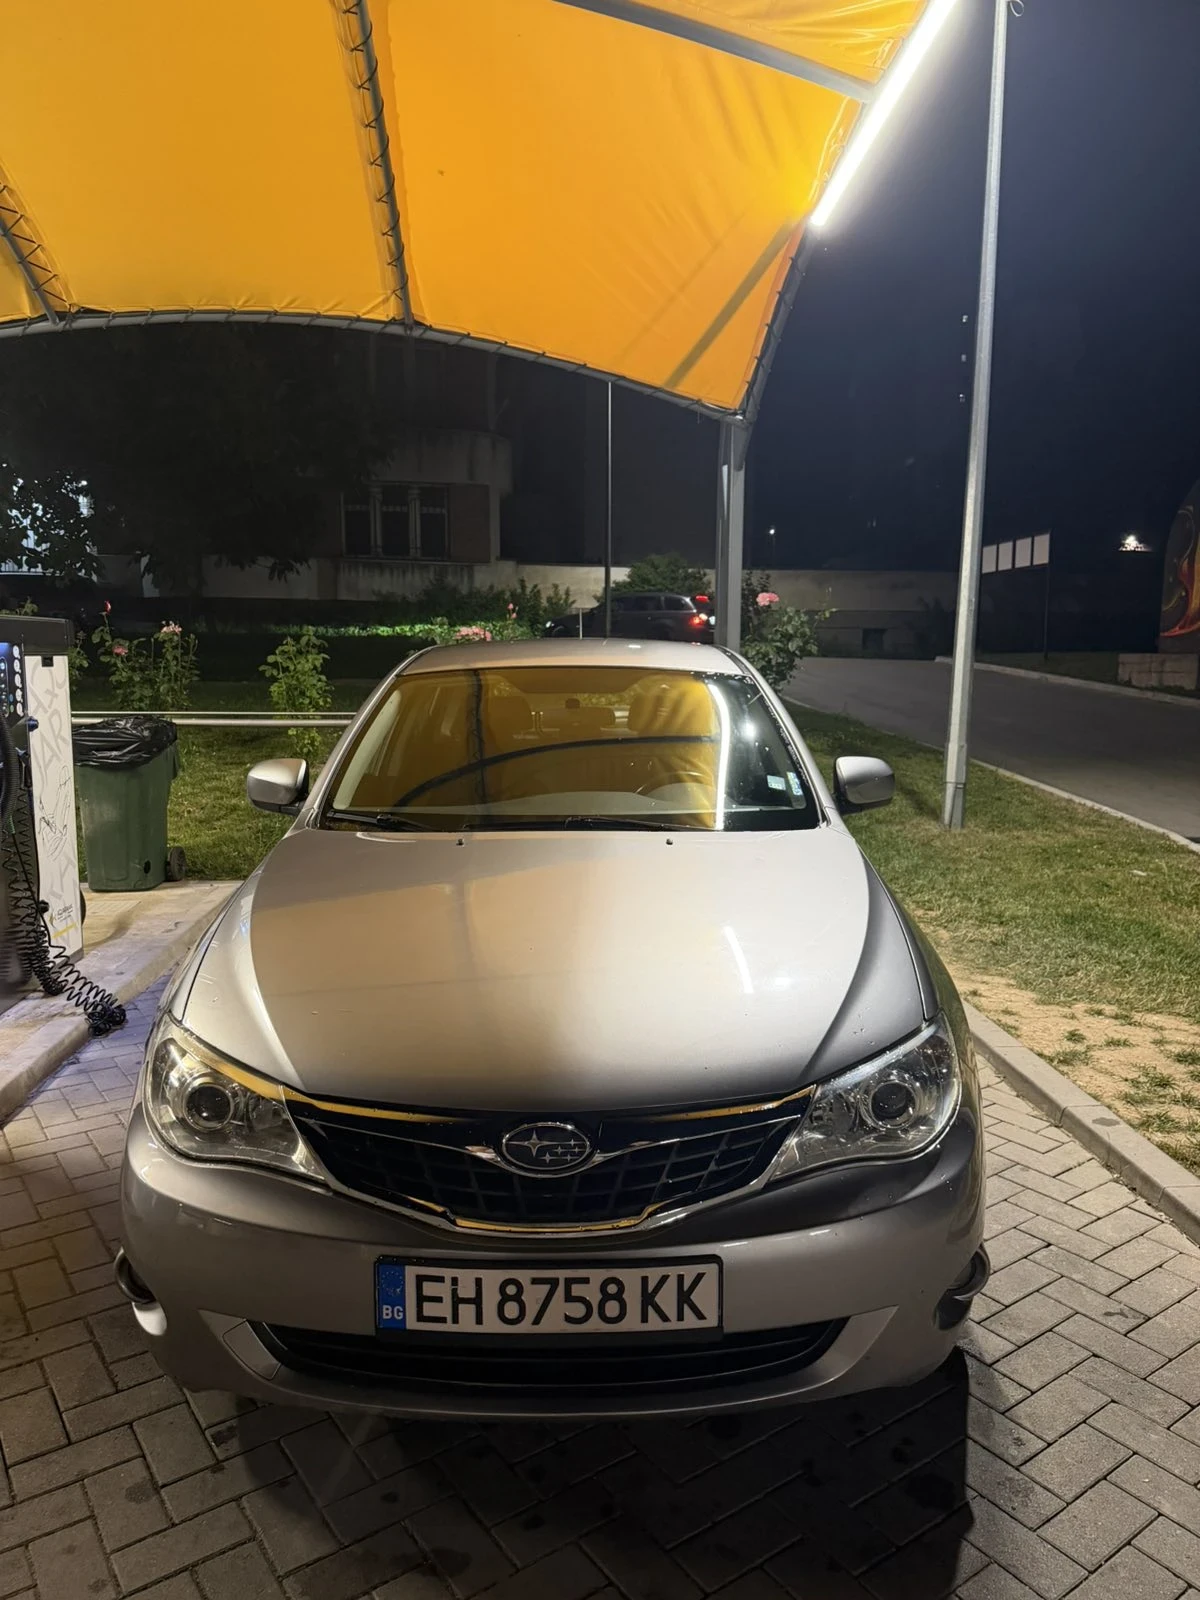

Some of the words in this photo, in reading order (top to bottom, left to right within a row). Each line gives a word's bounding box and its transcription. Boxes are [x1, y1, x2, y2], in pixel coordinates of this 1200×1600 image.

[382, 1305, 404, 1320] BG
[415, 1274, 484, 1326] EH
[497, 1276, 628, 1326] 8758
[640, 1272, 707, 1323] KK
